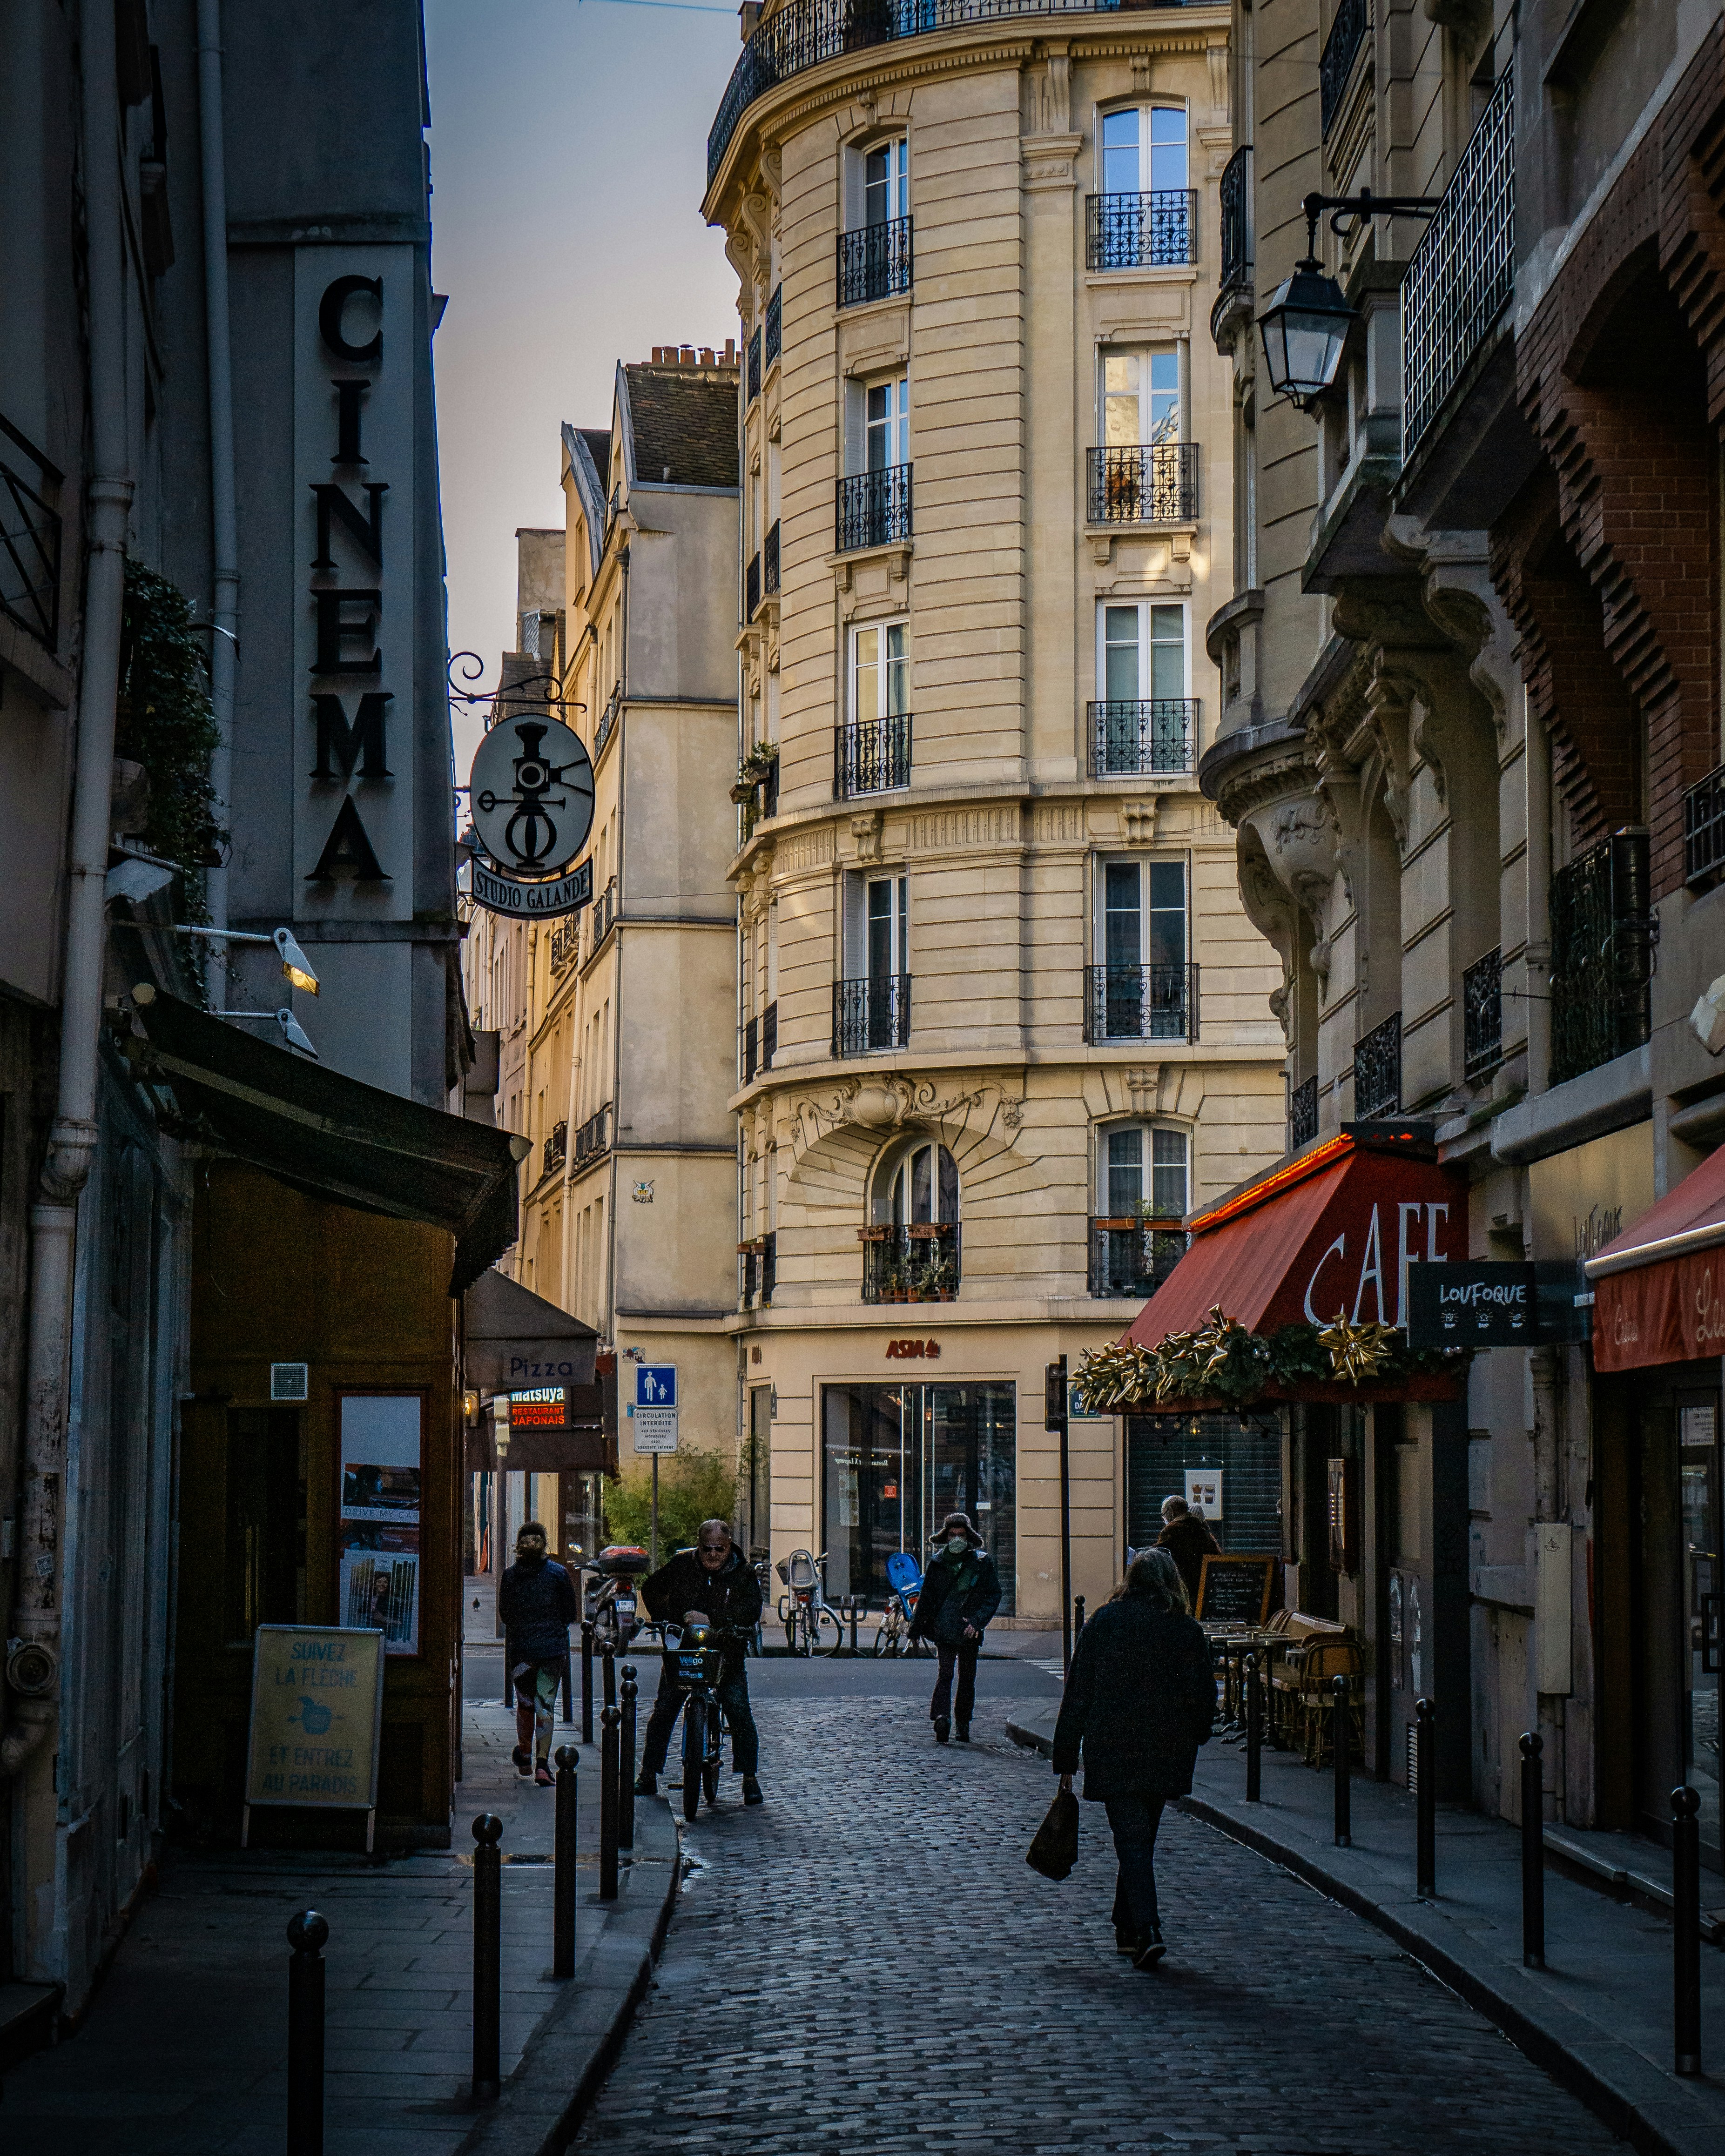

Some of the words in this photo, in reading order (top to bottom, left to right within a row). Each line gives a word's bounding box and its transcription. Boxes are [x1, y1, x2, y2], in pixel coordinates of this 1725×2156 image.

[304, 274, 396, 881] CINEMA
[476, 870, 522, 907] STUDIO
[526, 867, 588, 909] GALANDE
[1440, 1282, 1527, 1307] LOUFOQUE
[885, 1339, 924, 1359] ASIA
[511, 1357, 573, 1377] Pizza
[512, 1407, 565, 1415] RESTAURANT
[512, 1415, 565, 1425] JAPONAIS
[345, 1508, 375, 1517] DRIVE
[398, 1511, 418, 1519] CAR
[290, 1642, 346, 1662] SUIVEZ
[276, 1667, 296, 1686] LA
[269, 1746, 287, 1765] ET
[294, 1747, 353, 1768] ENTREZ
[262, 1773, 285, 1791] AU
[289, 1774, 357, 1794] PARADIS
